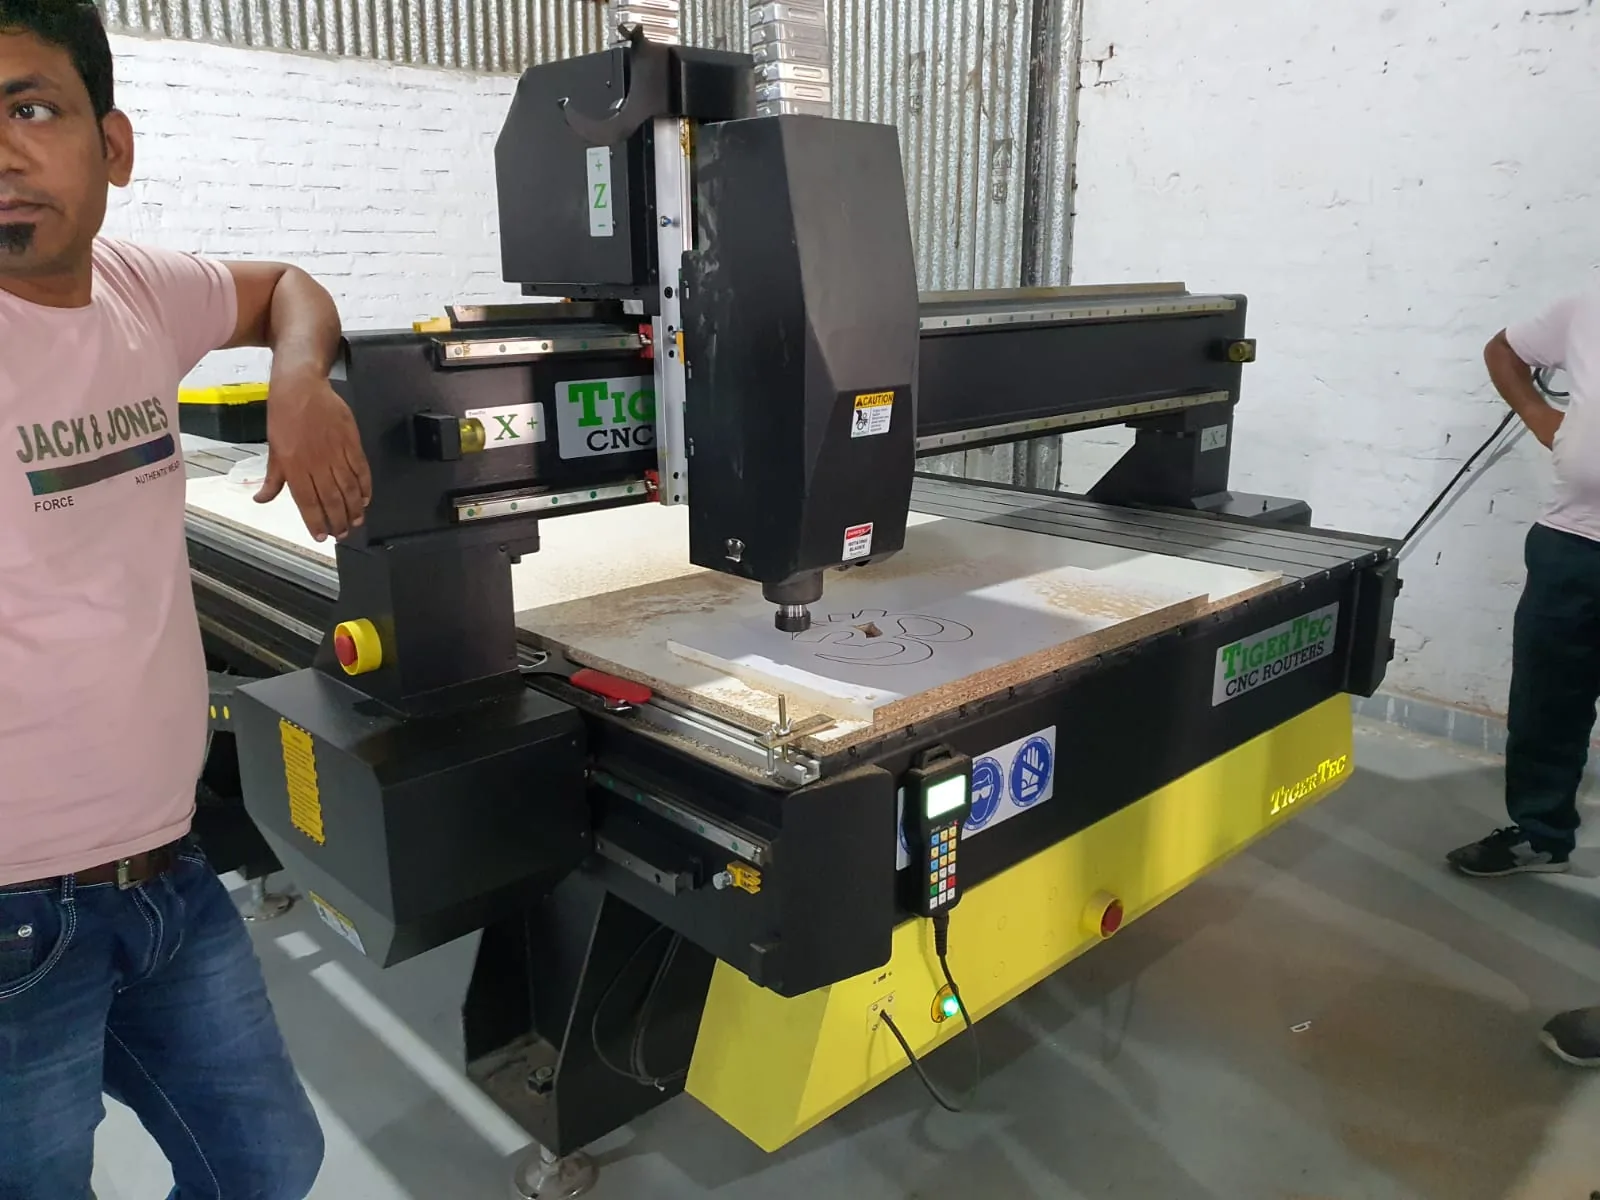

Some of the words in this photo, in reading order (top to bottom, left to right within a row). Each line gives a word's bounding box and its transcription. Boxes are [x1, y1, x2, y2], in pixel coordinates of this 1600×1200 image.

[593, 183, 607, 208] Z
[863, 394, 894, 406] CAUTION
[16, 417, 90, 463] JACK
[90, 414, 103, 449] &
[107, 396, 169, 444] JONES
[587, 424, 654, 451] CNC
[34, 495, 75, 512] FORCE
[1225, 669, 1259, 696] CNC
[1263, 641, 1324, 680] ROUTERS
